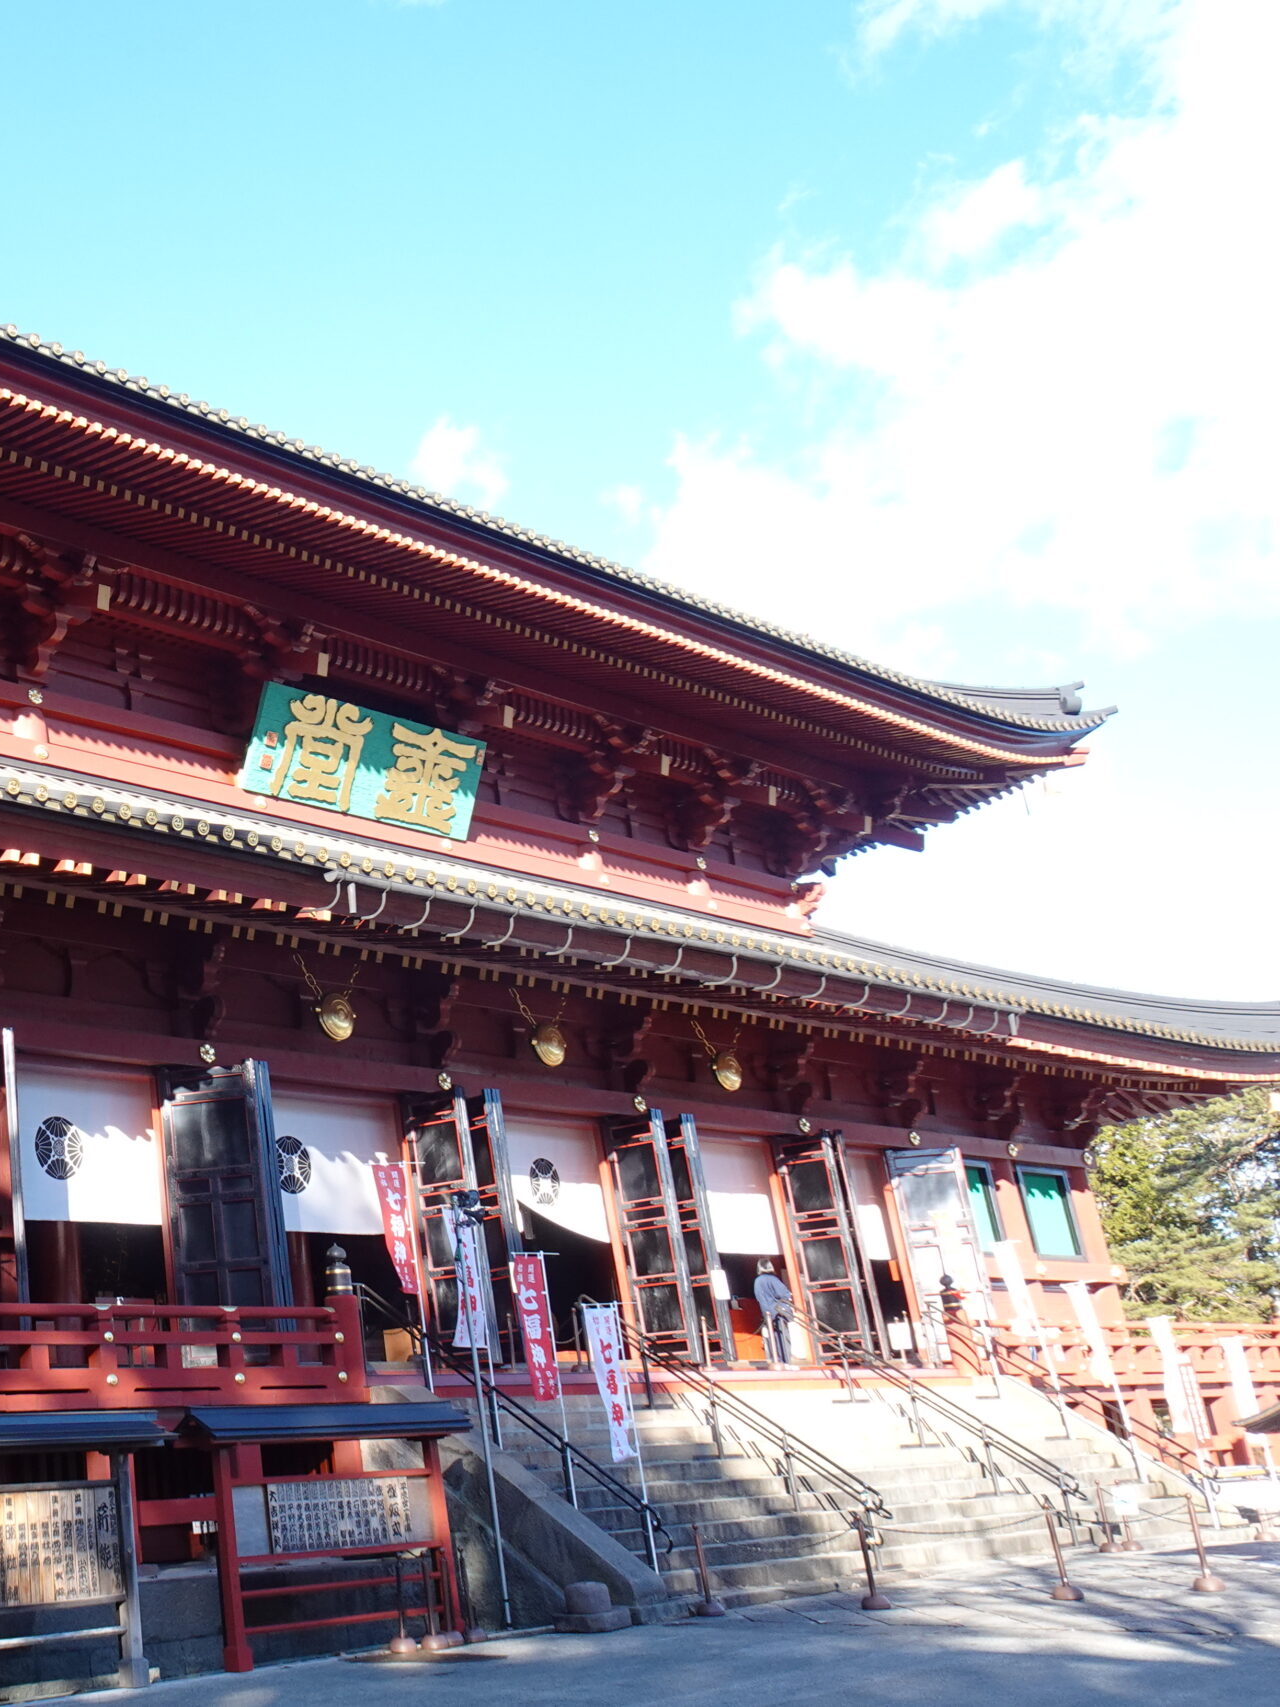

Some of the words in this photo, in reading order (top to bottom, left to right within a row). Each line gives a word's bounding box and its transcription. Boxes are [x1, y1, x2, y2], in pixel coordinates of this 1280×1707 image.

[386, 1188, 407, 1265] 七福神
[518, 1284, 547, 1369] 七福神
[599, 1338, 625, 1428] 七福神
